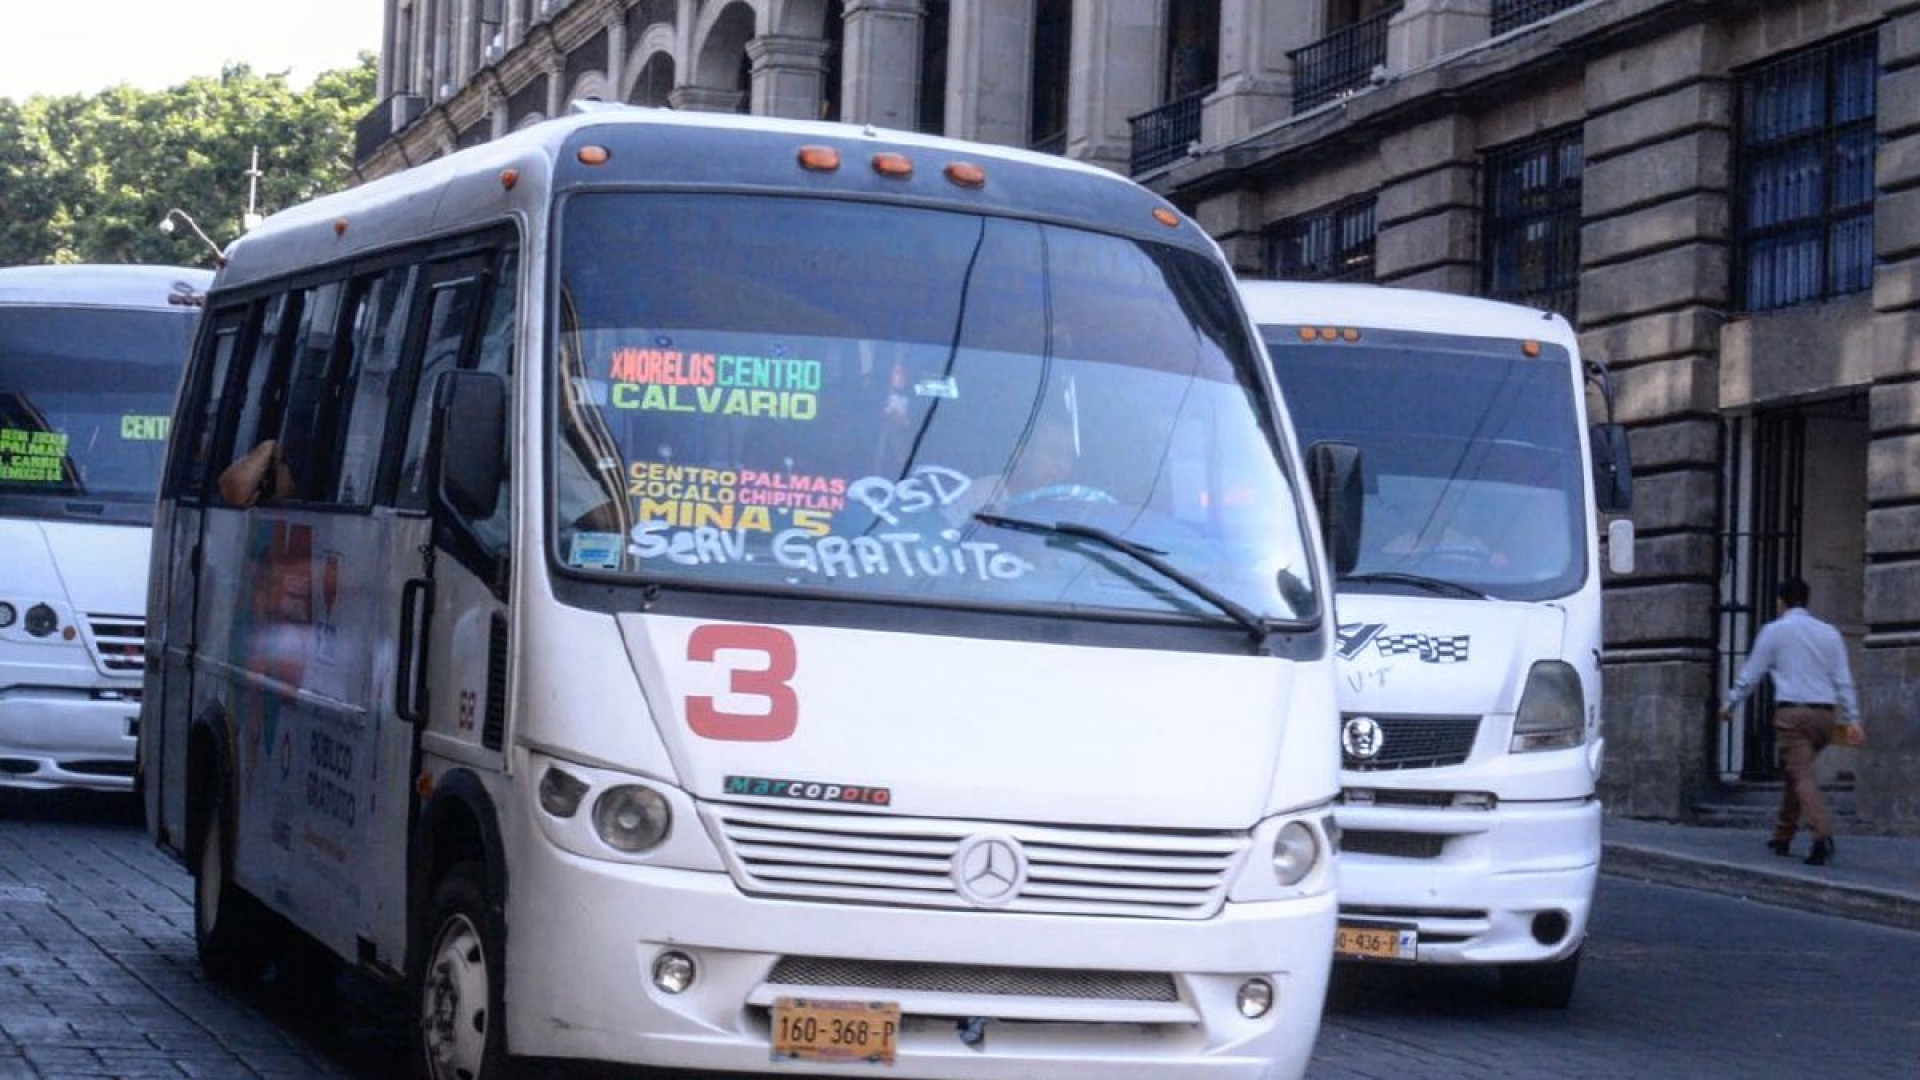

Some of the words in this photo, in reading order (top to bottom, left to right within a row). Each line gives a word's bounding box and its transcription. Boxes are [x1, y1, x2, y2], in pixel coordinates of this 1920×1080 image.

[717, 355, 821, 391] CENTRO
[612, 383, 817, 420] CALVARIO
[121, 415, 171, 440] CENT
[629, 462, 737, 485] CENTRO
[740, 469, 845, 493] PALMAS
[628, 479, 736, 503] ZOCALO
[738, 488, 845, 510] CHIPITLAN
[685, 623, 799, 743] 3
[781, 1015, 895, 1046] 160-368-P
